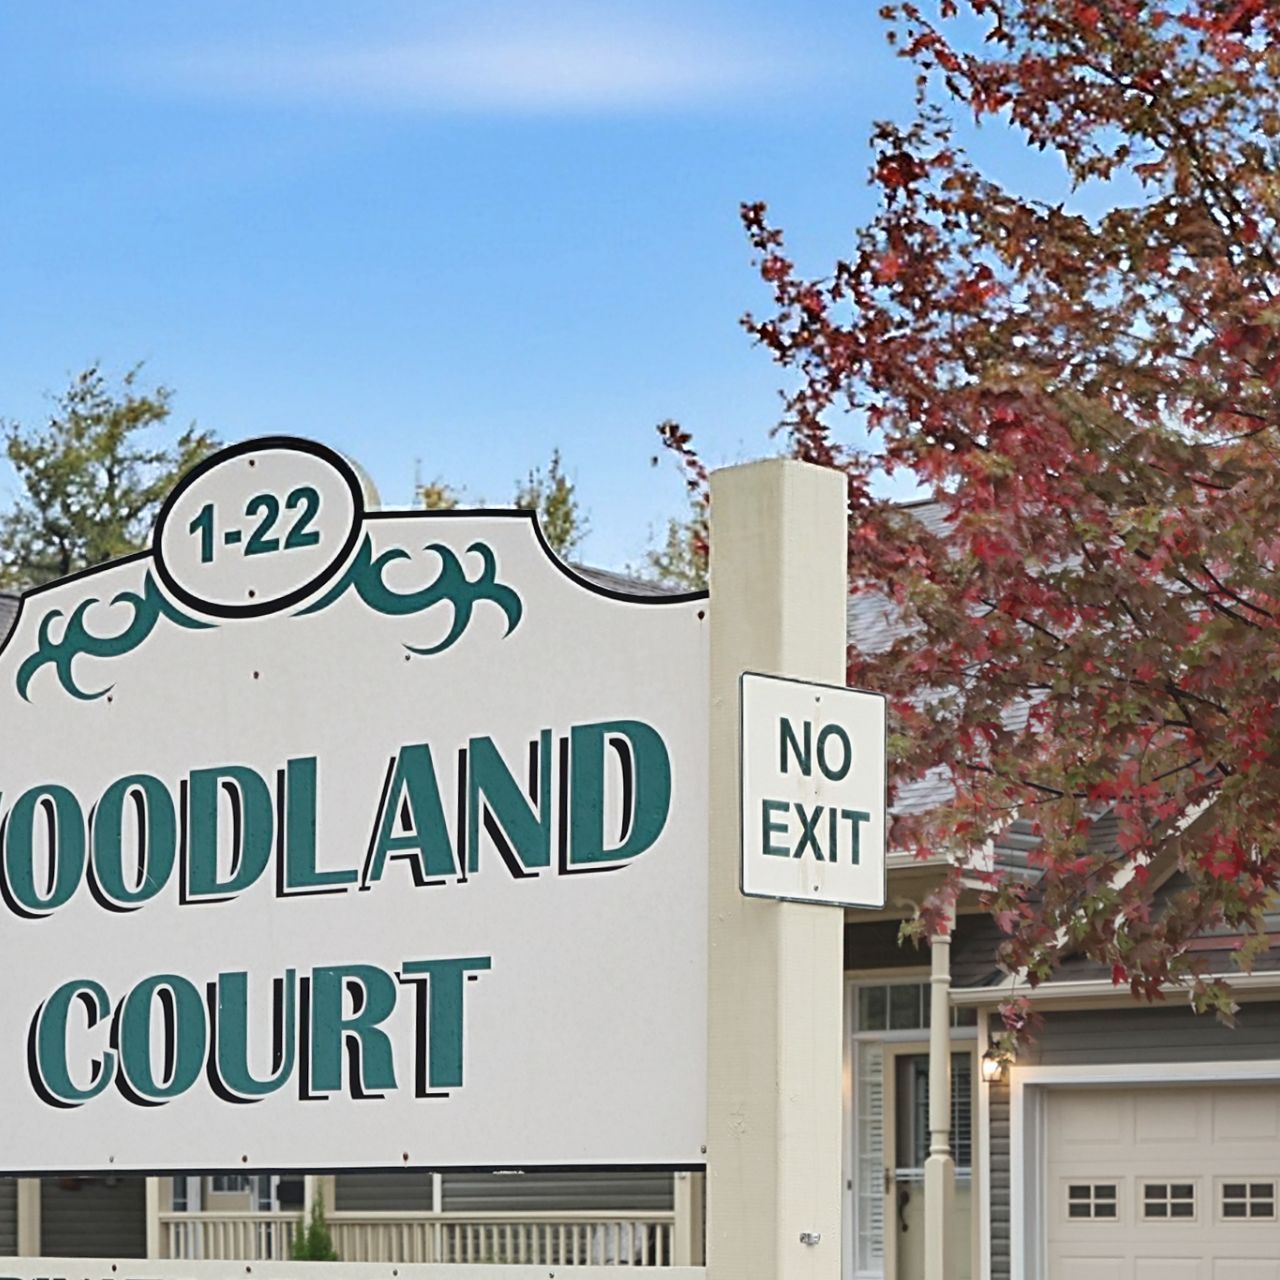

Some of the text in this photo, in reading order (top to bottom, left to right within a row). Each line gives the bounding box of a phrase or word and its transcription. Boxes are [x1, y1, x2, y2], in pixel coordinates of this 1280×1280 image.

[189, 486, 320, 564] 1-22
[781, 718, 851, 781] NO
[763, 800, 869, 864] EXIT
[27, 957, 491, 1108] COURT
